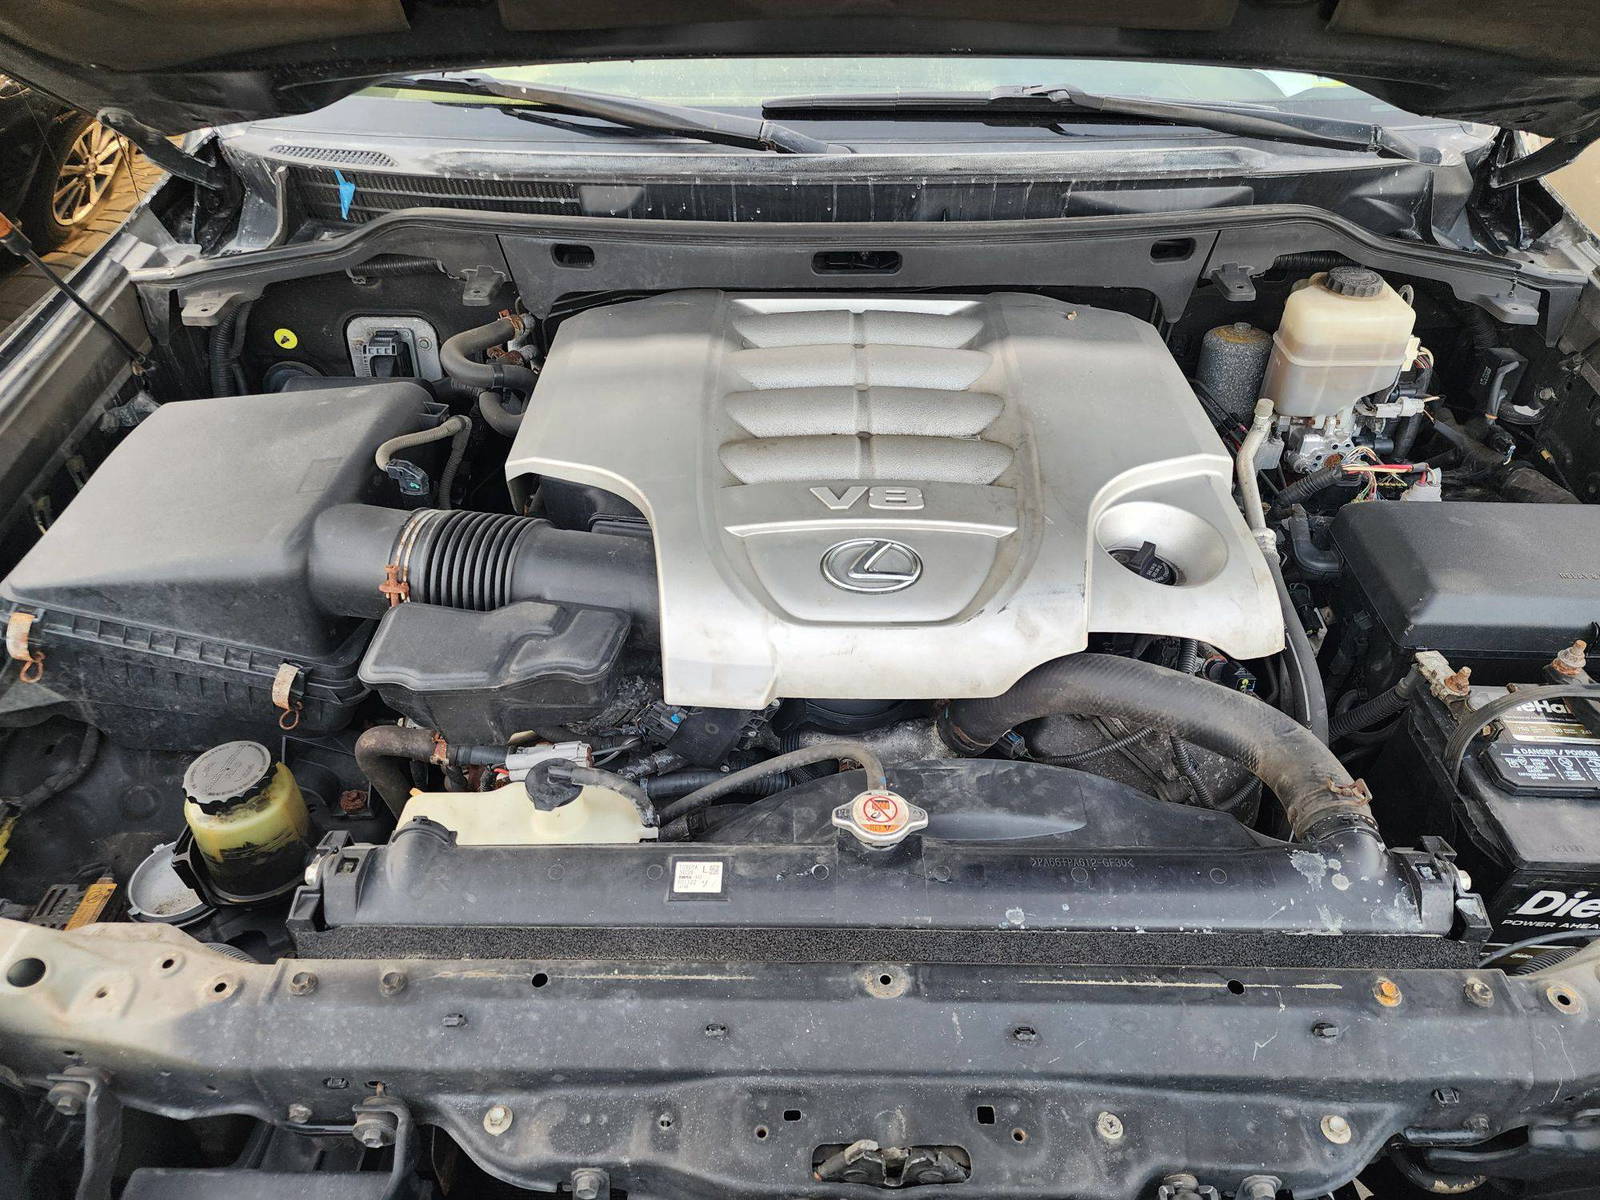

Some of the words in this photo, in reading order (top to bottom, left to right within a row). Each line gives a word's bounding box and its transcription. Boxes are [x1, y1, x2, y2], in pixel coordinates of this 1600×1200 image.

[809, 486, 925, 511] V8
[1521, 748, 1557, 756] DANGER
[1566, 749, 1599, 757] POISON
[1515, 890, 1600, 918] Die
[1501, 919, 1556, 928] POWER
[1559, 922, 1600, 930] AHEA
